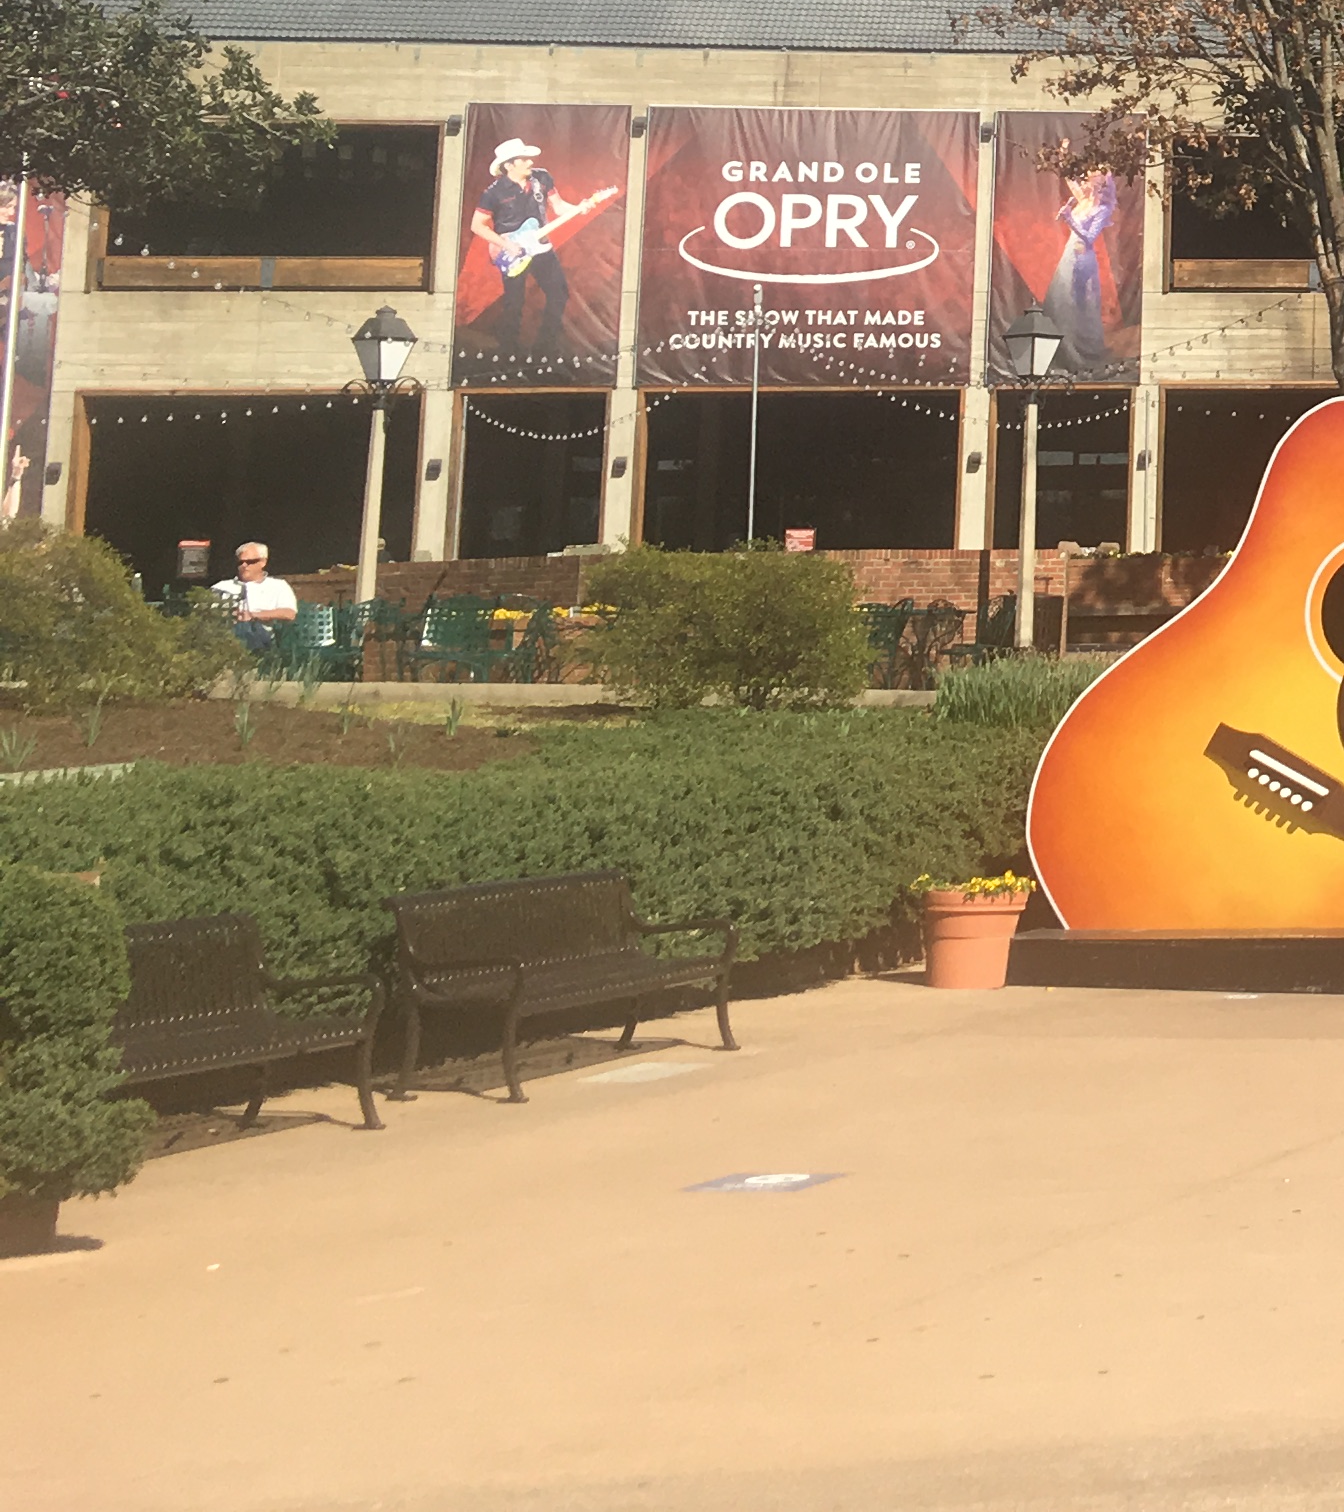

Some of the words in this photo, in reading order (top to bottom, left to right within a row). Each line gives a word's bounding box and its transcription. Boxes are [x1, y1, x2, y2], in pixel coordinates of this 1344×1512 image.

[721, 160, 845, 183] GRAND
[855, 162, 921, 184] OLE
[713, 191, 919, 250] OPRY
[687, 310, 729, 326] THE
[804, 310, 858, 326] THAT
[864, 310, 925, 326] MADE
[668, 333, 776, 349] COUNTRY
[778, 333, 847, 349] MUSIC
[853, 333, 942, 348] FAMOUS
